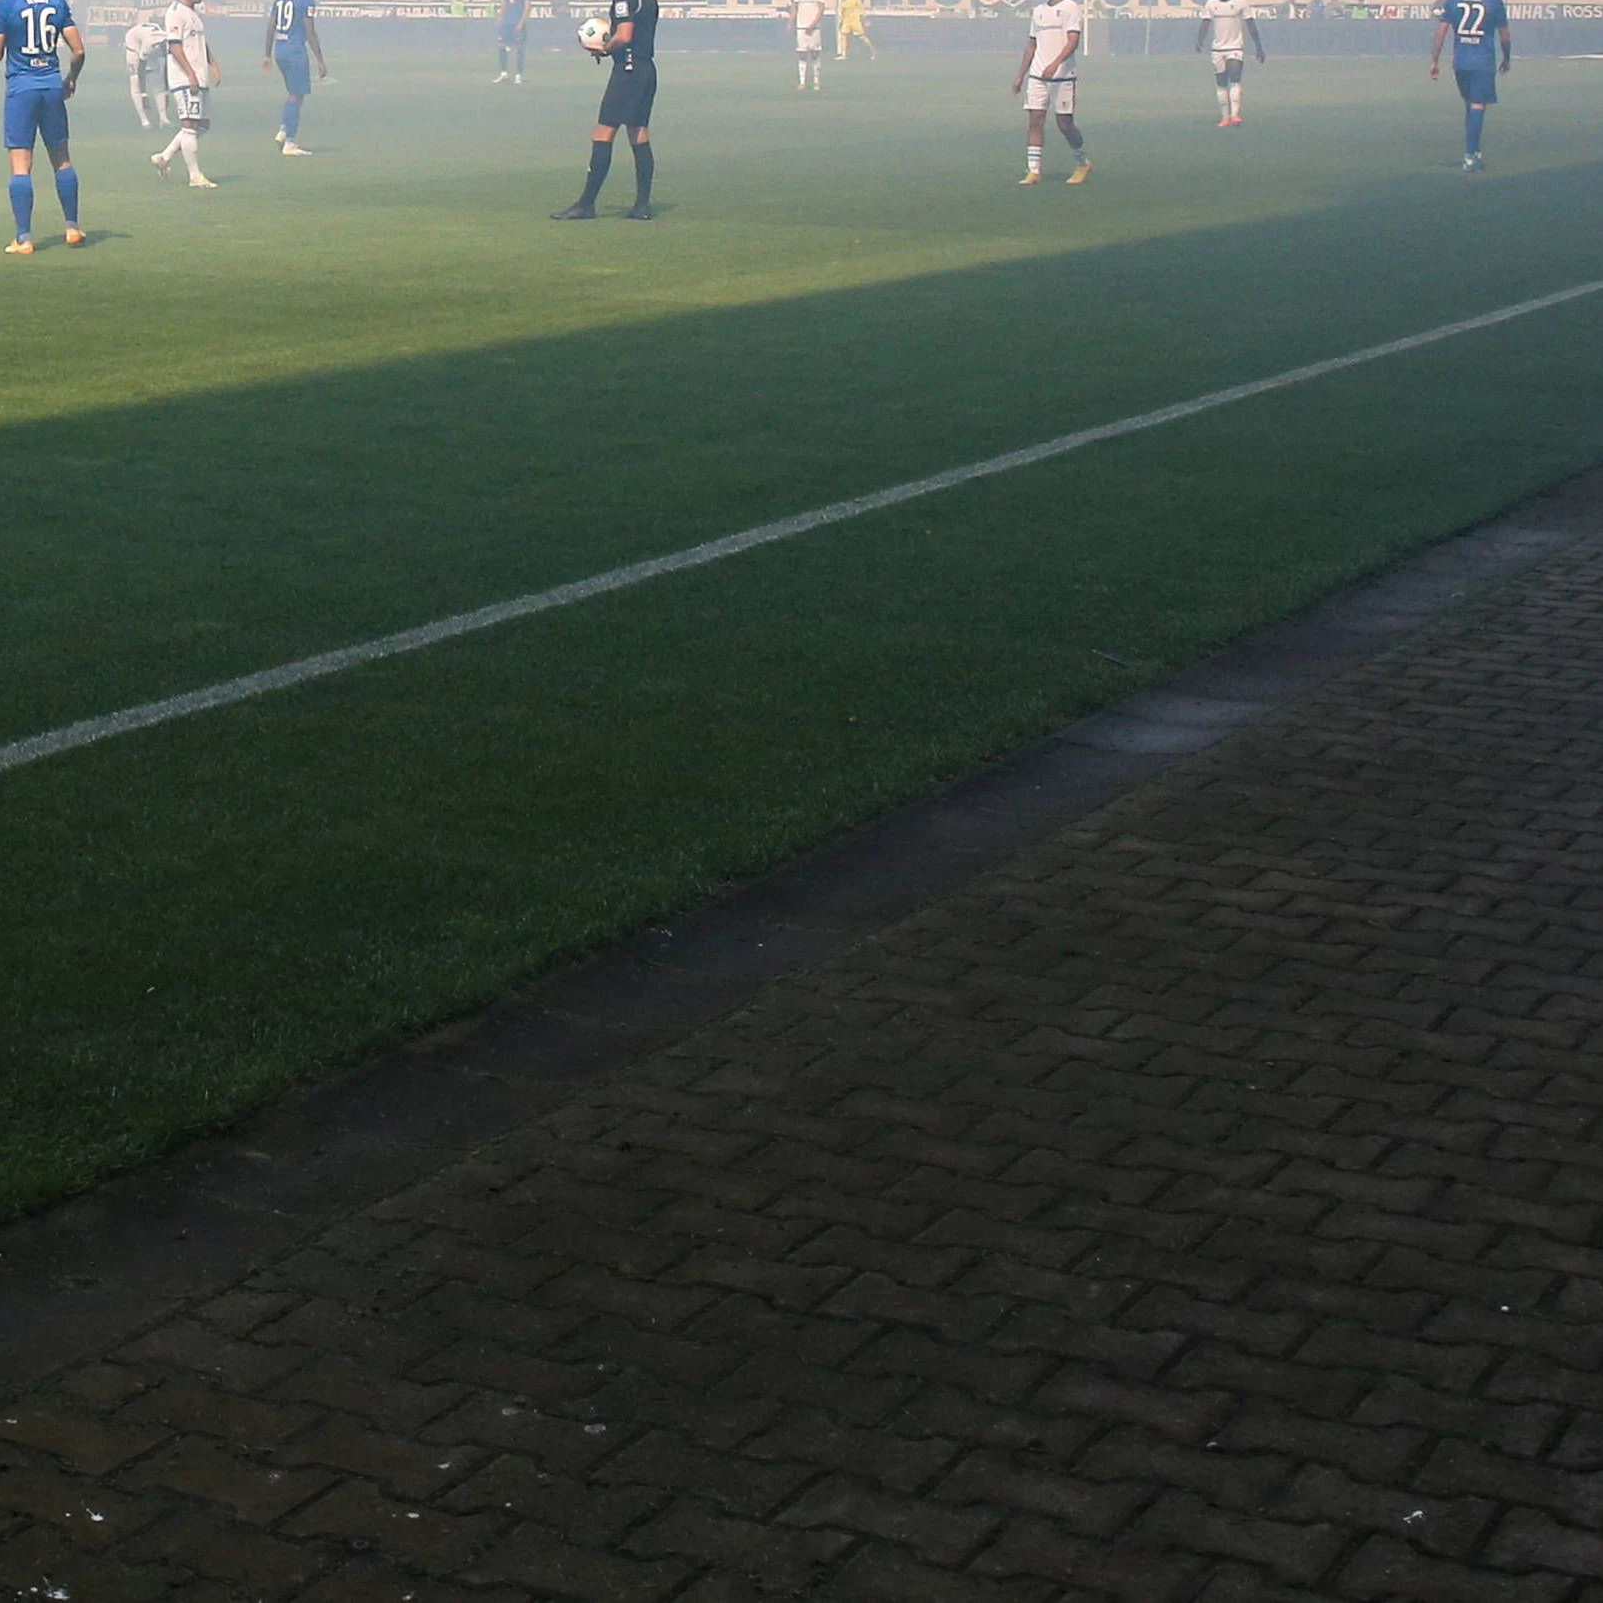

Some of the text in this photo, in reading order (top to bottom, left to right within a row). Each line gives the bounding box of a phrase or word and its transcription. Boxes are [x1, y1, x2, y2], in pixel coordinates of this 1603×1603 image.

[20, 7, 57, 54] 16
[275, 0, 294, 31] 19
[1456, 2, 1486, 35] 22
